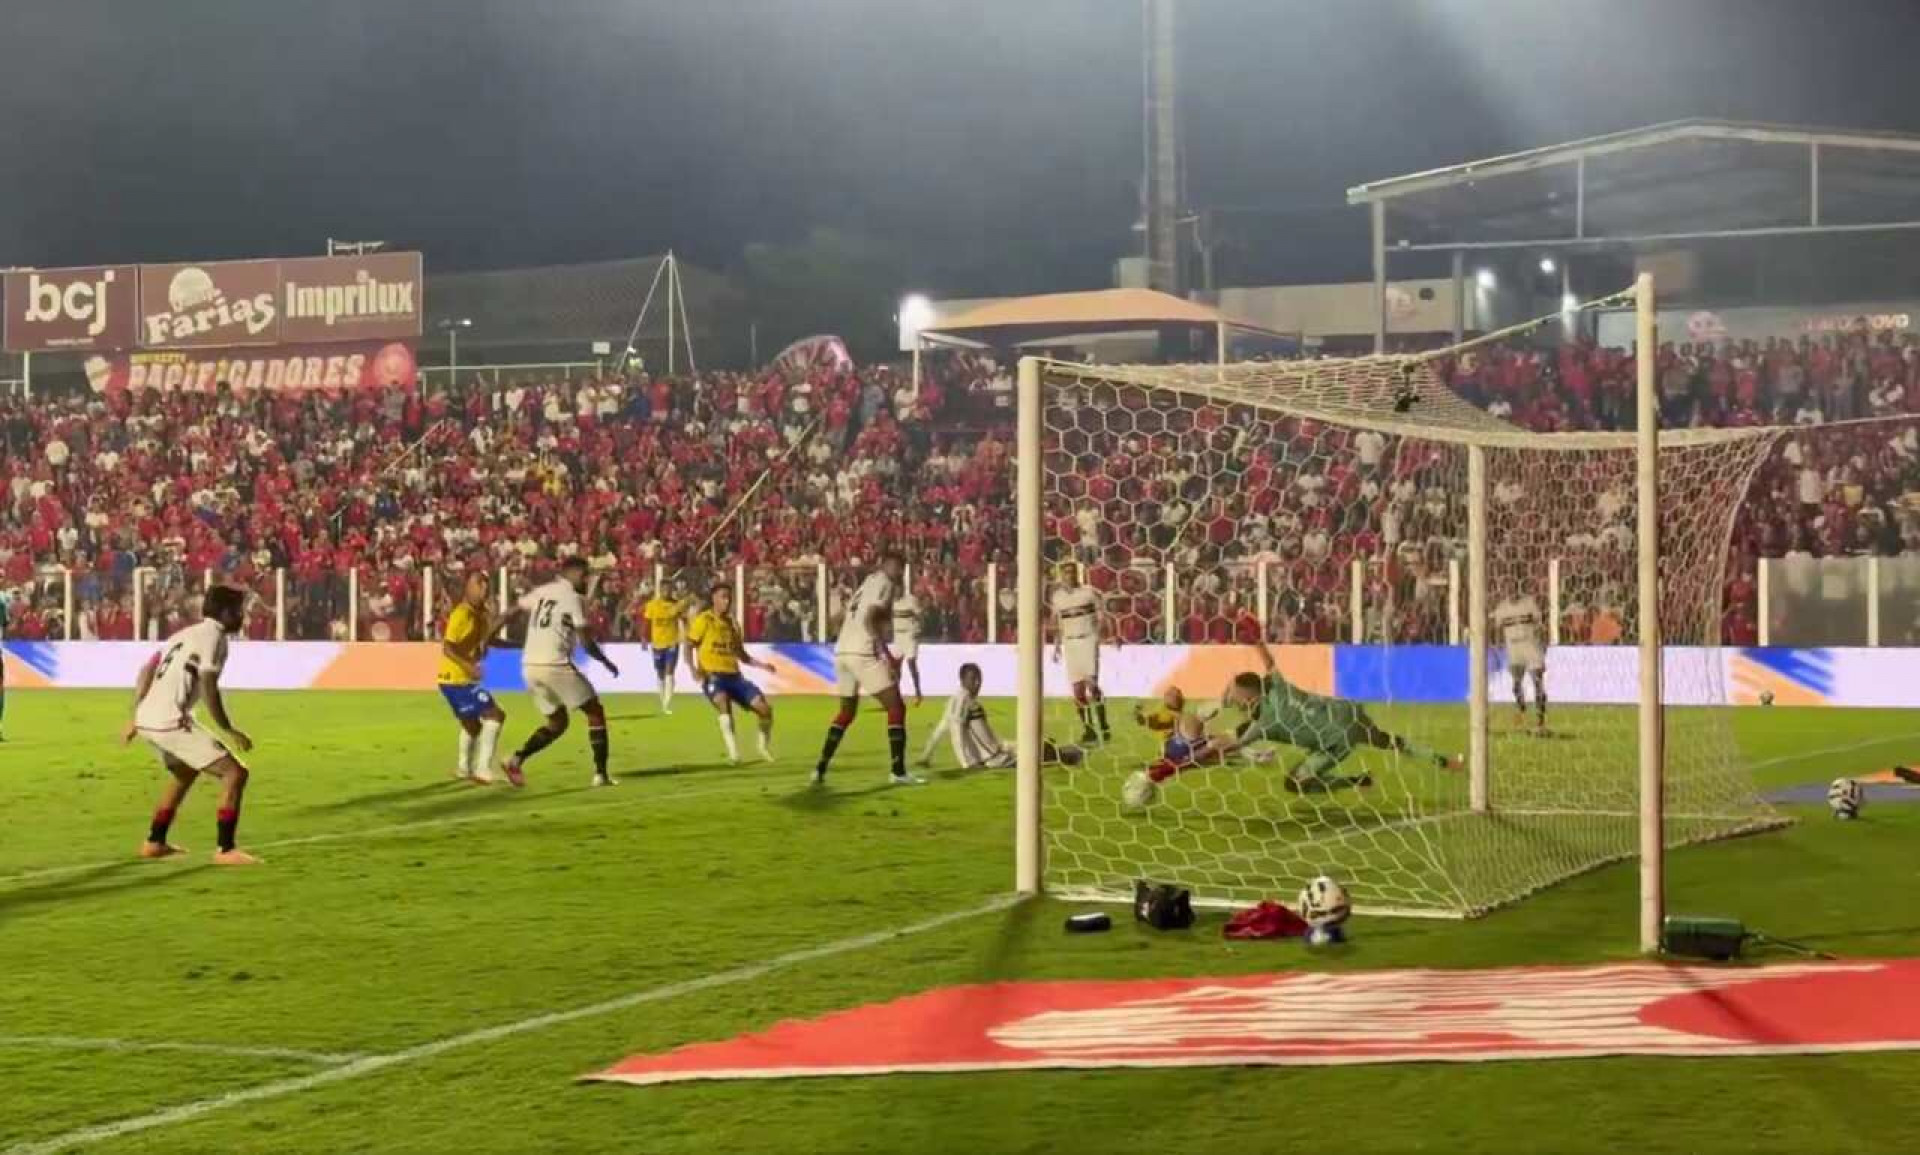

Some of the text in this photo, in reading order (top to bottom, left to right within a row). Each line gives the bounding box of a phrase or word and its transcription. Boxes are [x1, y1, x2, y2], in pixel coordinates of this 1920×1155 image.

[24, 269, 115, 336] bcj
[144, 292, 276, 345] Farias
[286, 269, 414, 325] Imprilux
[535, 597, 559, 628] 13
